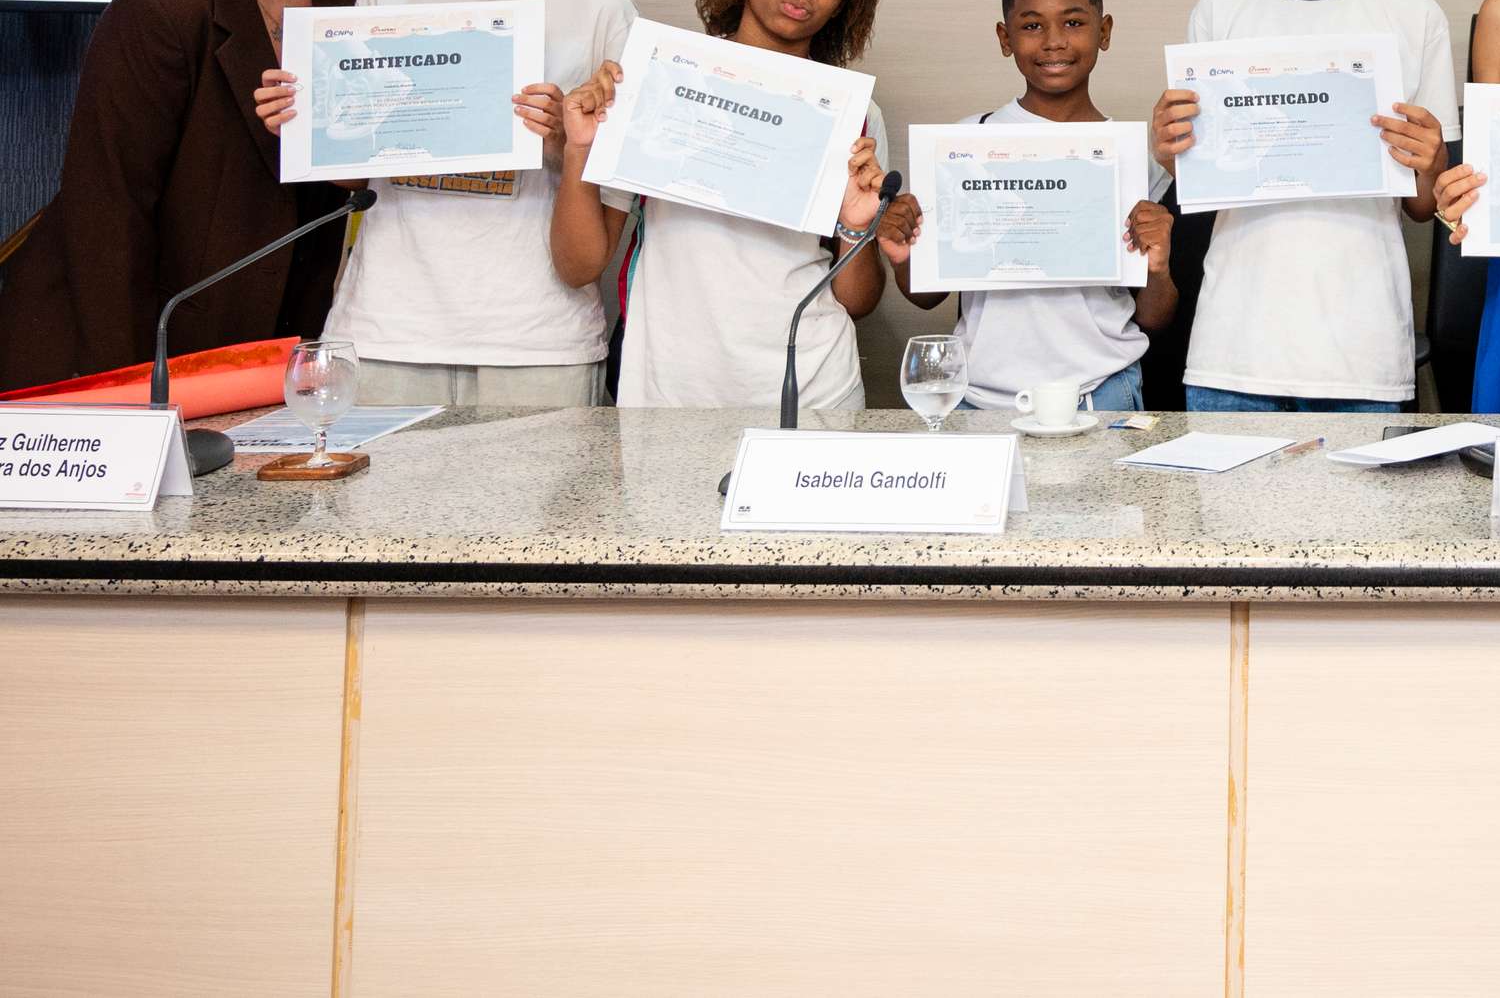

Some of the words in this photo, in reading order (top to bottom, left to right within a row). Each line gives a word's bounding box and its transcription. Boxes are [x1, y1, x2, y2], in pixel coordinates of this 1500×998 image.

[338, 52, 463, 71] CERTIFICADO
[674, 85, 784, 127] CERTIFICADO
[1223, 92, 1330, 108] CERTIFICADO
[961, 179, 1068, 191] CERTIFICADO
[12, 433, 101, 452] Guilherme
[19, 459, 52, 477] dos
[55, 459, 107, 482] Anjos
[795, 470, 864, 489] Isabella
[870, 470, 947, 489] Gandolfi
